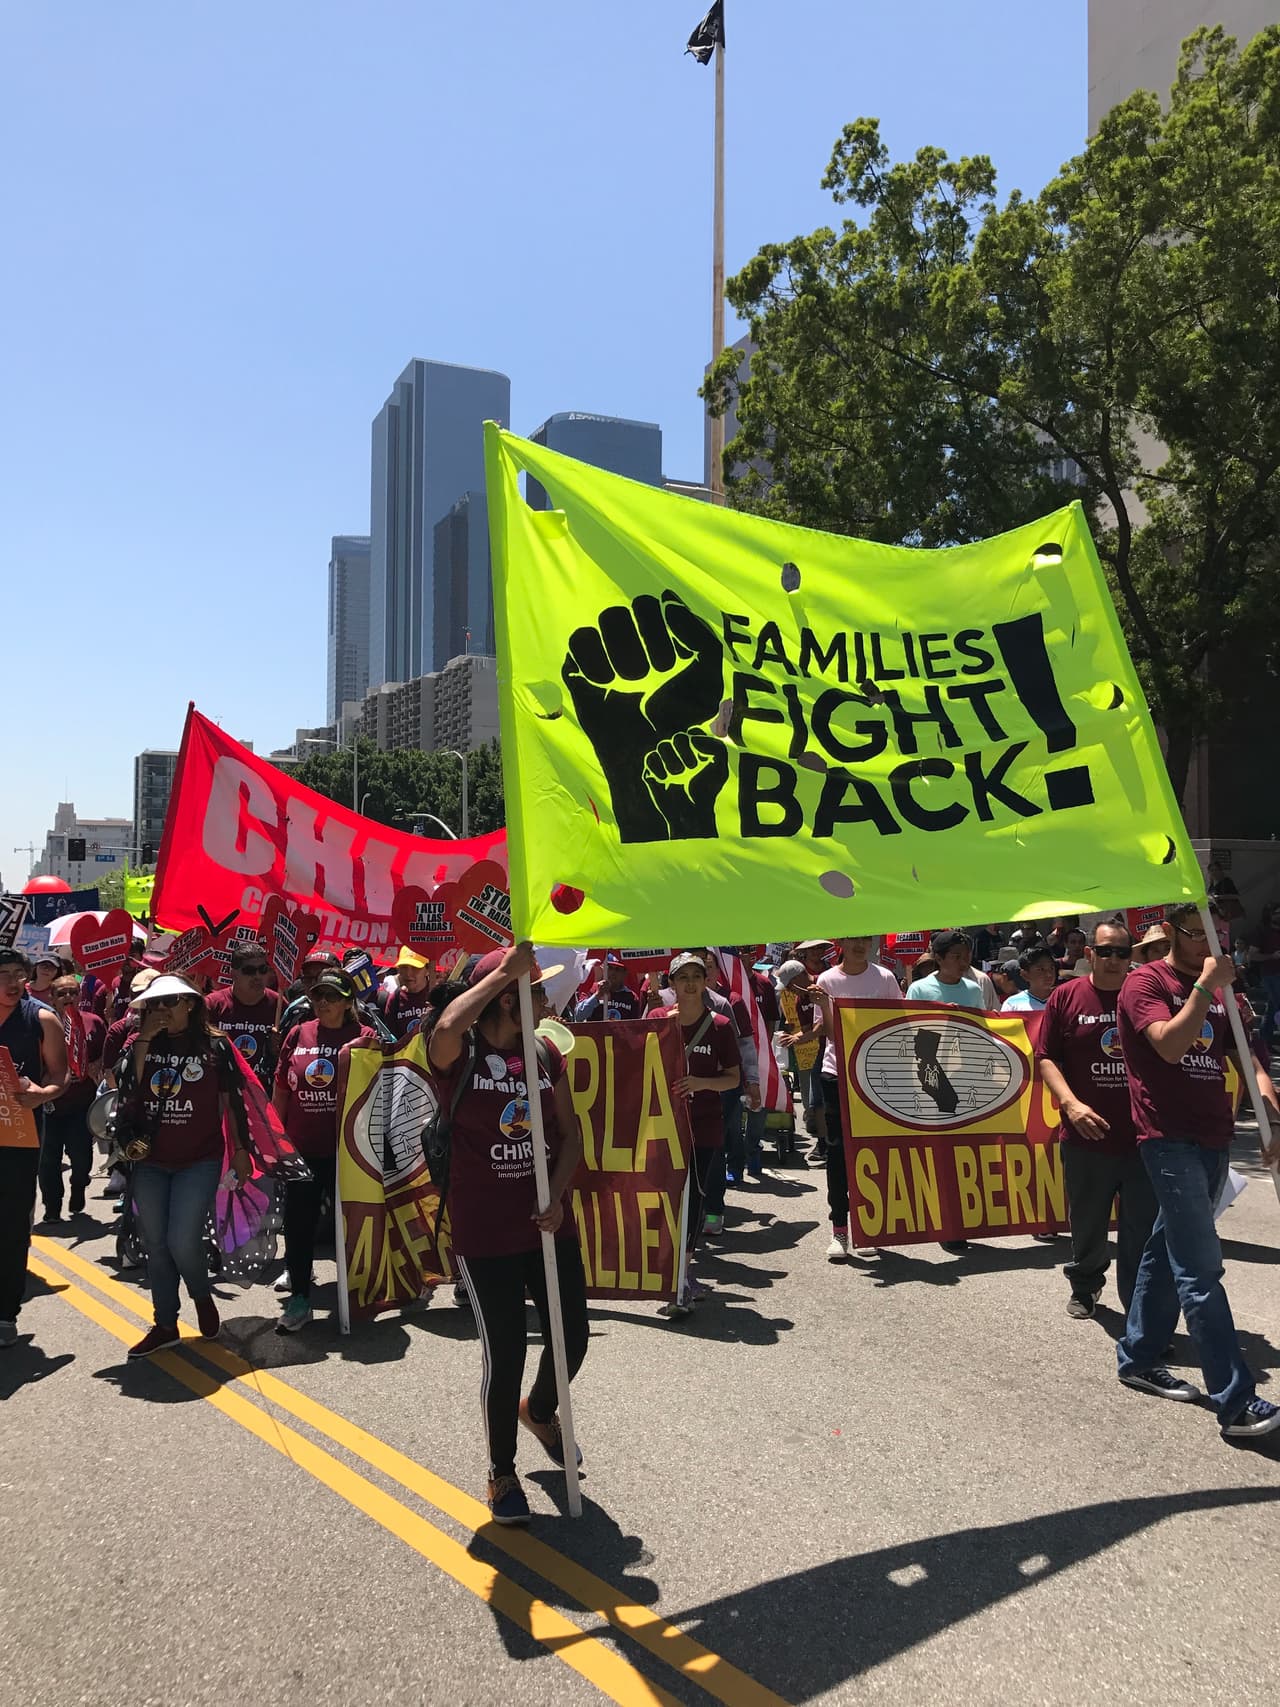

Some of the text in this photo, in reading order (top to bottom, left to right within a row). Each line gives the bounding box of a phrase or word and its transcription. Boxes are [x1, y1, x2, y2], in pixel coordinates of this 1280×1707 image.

[722, 612, 996, 684] FAMILIES
[734, 674, 1007, 763] FIGHT
[469, 897, 486, 914] THE
[417, 914, 442, 922] A LAS
[491, 1160, 531, 1170] Coalition for
[498, 1169, 531, 1180] Immigrant
[855, 1146, 944, 1237] SAN
